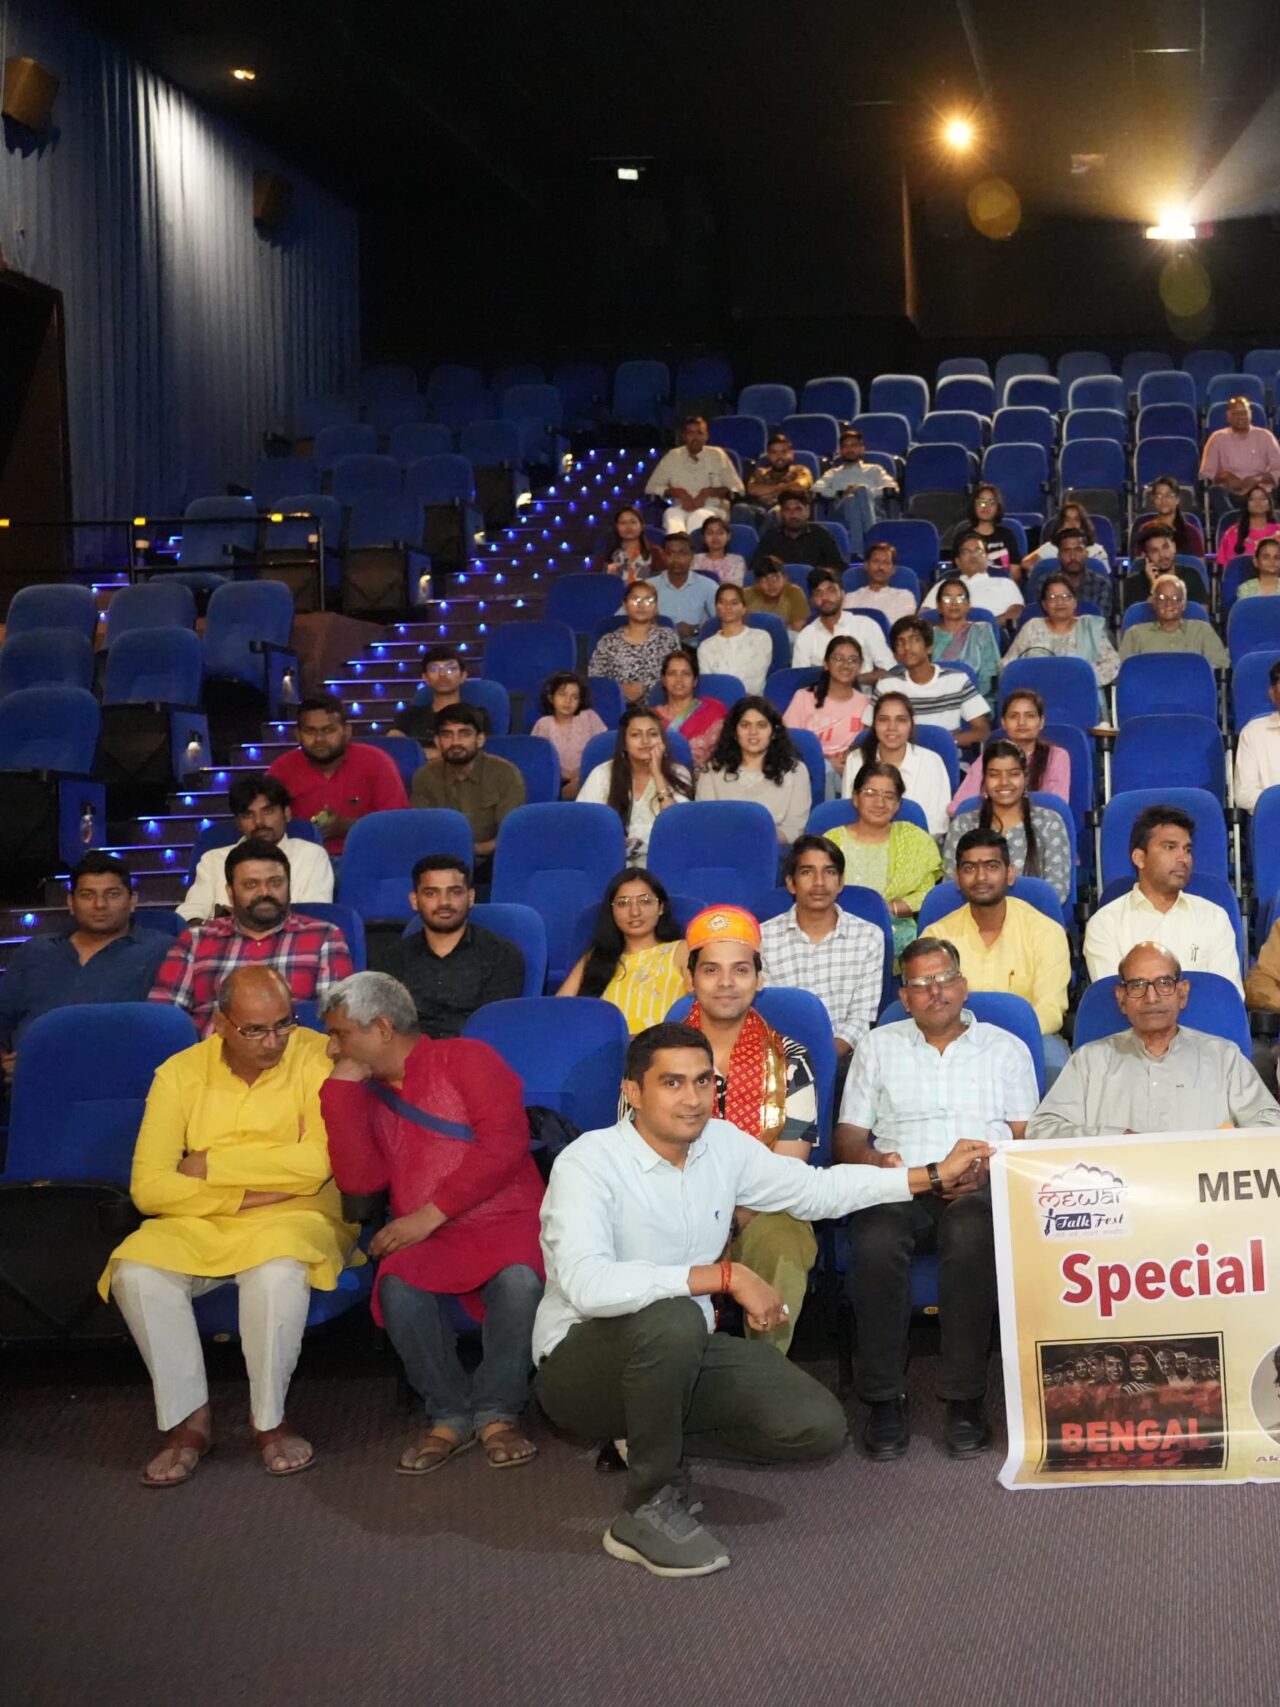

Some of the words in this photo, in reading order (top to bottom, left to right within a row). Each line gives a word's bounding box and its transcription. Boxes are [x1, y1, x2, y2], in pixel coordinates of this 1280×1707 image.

[1056, 1215, 1091, 1229] Talk
[1093, 1213, 1123, 1228] Fest
[1062, 1239, 1265, 1317] Special
[1061, 1418, 1208, 1453] BENGAL
